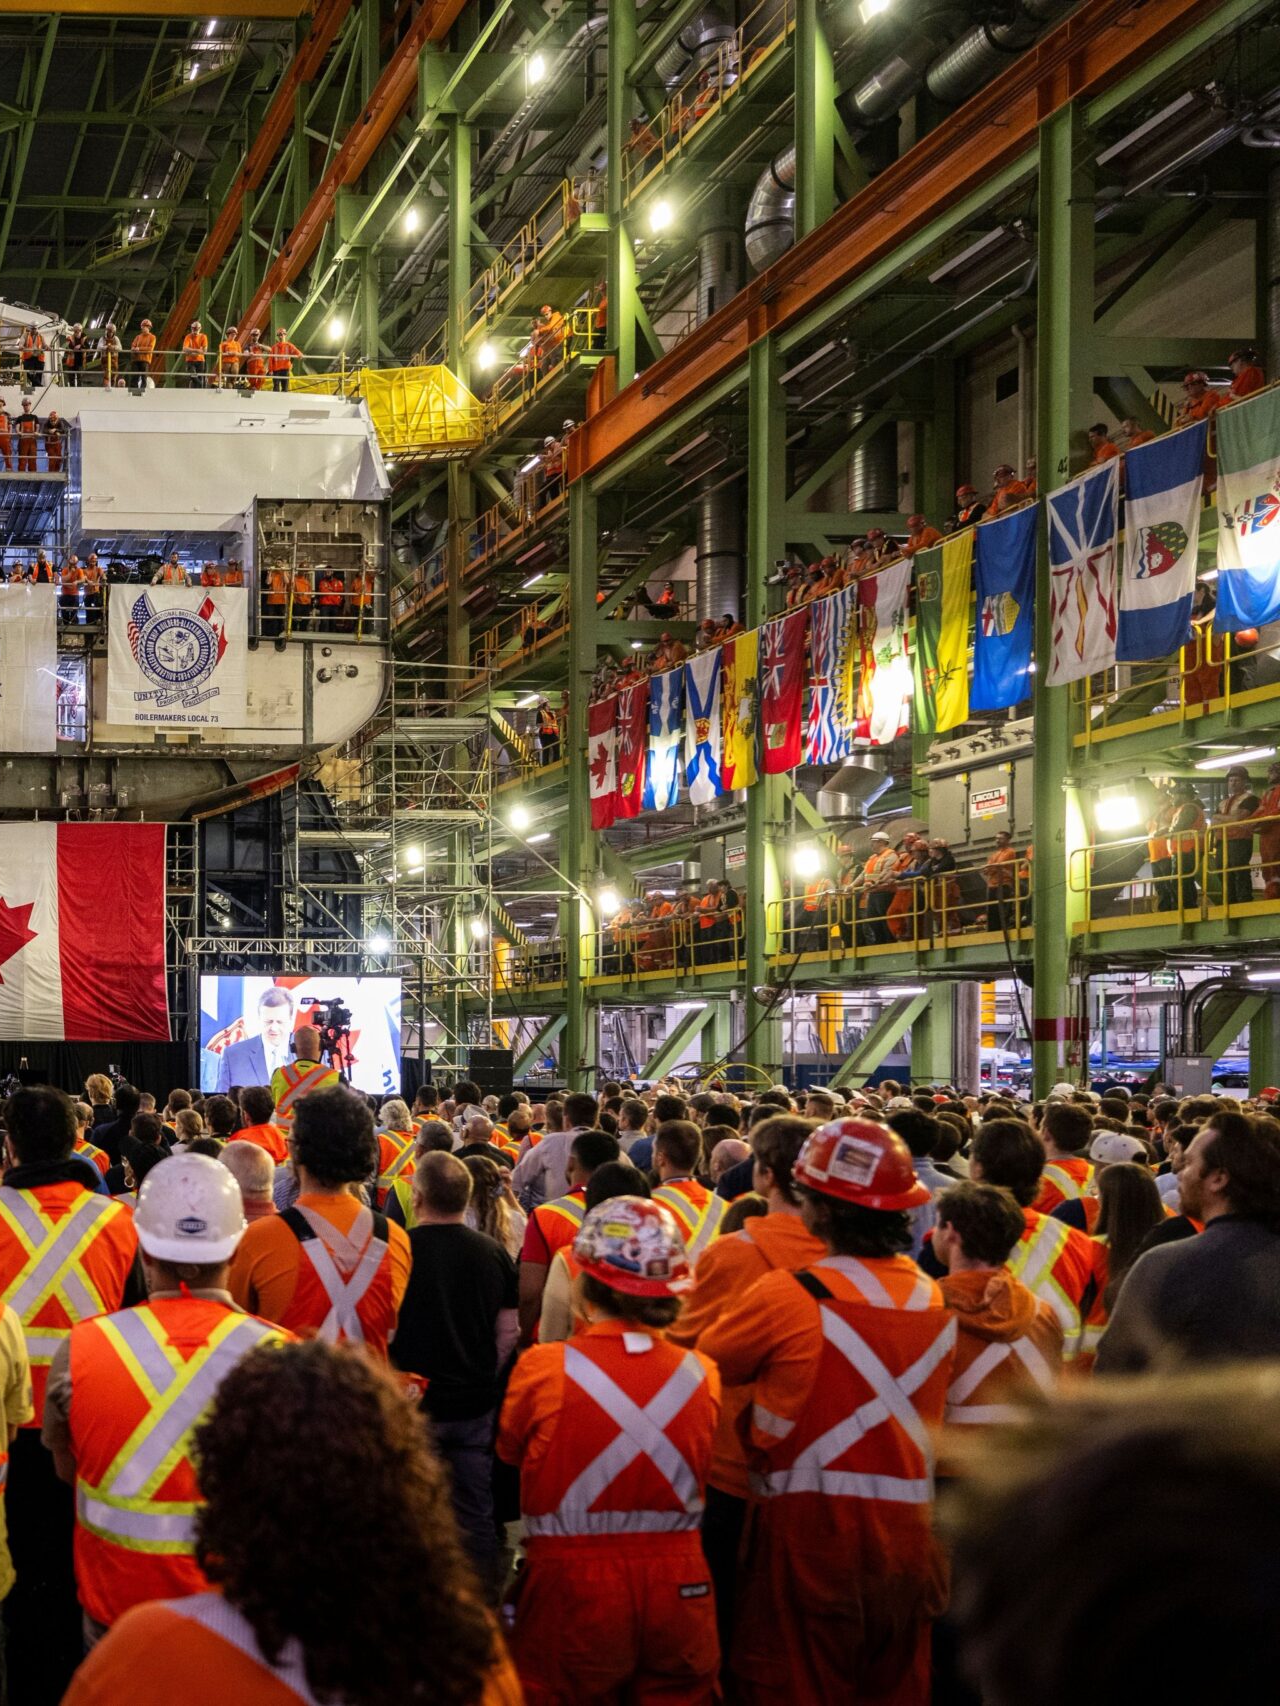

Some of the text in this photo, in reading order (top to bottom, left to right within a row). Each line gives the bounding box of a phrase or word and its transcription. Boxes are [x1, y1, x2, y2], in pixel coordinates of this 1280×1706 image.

[137, 689, 164, 700] UNITY
[160, 690, 188, 705] PROGRESS
[185, 690, 218, 706] PROTECTION
[135, 713, 186, 722] BOILERMAKERS
[211, 715, 219, 723] 73
